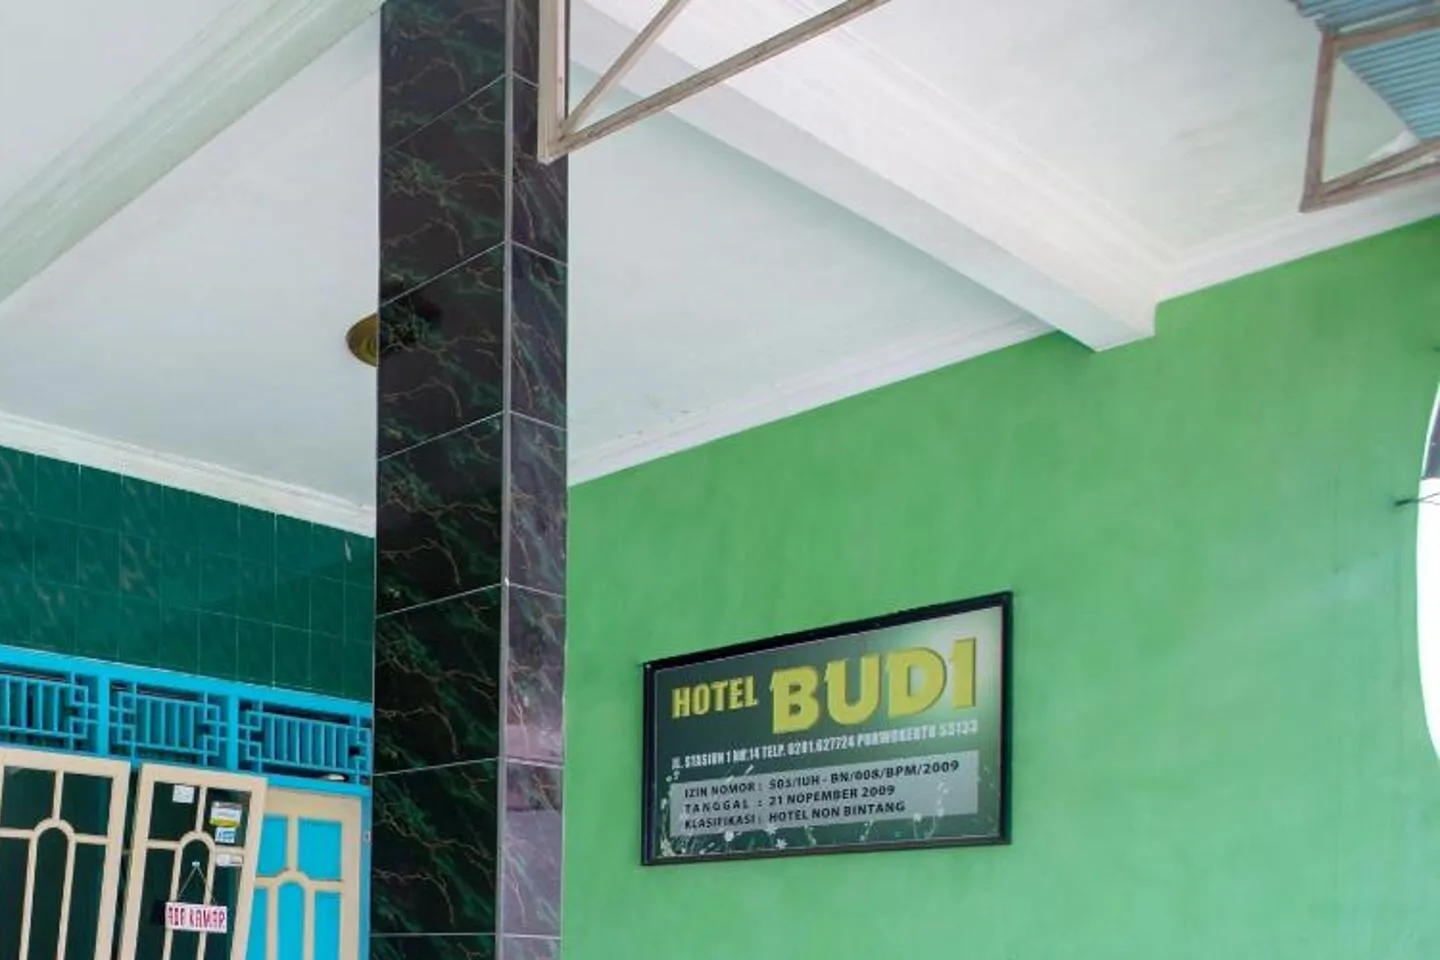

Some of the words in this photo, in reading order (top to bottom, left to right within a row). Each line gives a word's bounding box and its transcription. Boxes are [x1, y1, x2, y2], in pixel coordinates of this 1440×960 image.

[671, 675, 758, 719] HOTEL
[770, 636, 977, 735] BUDI
[684, 787, 708, 799] IZIN
[684, 800, 750, 814] TANGGAL
[768, 795, 783, 807] 21
[786, 788, 858, 804] NOPEMBER
[861, 785, 896, 798] 2009
[684, 813, 755, 829] KLASIFIKASI
[768, 809, 809, 823] HOTEL
[811, 806, 840, 819] NON
[843, 801, 907, 817] BINTANG
[189, 908, 225, 929] KAMAR
